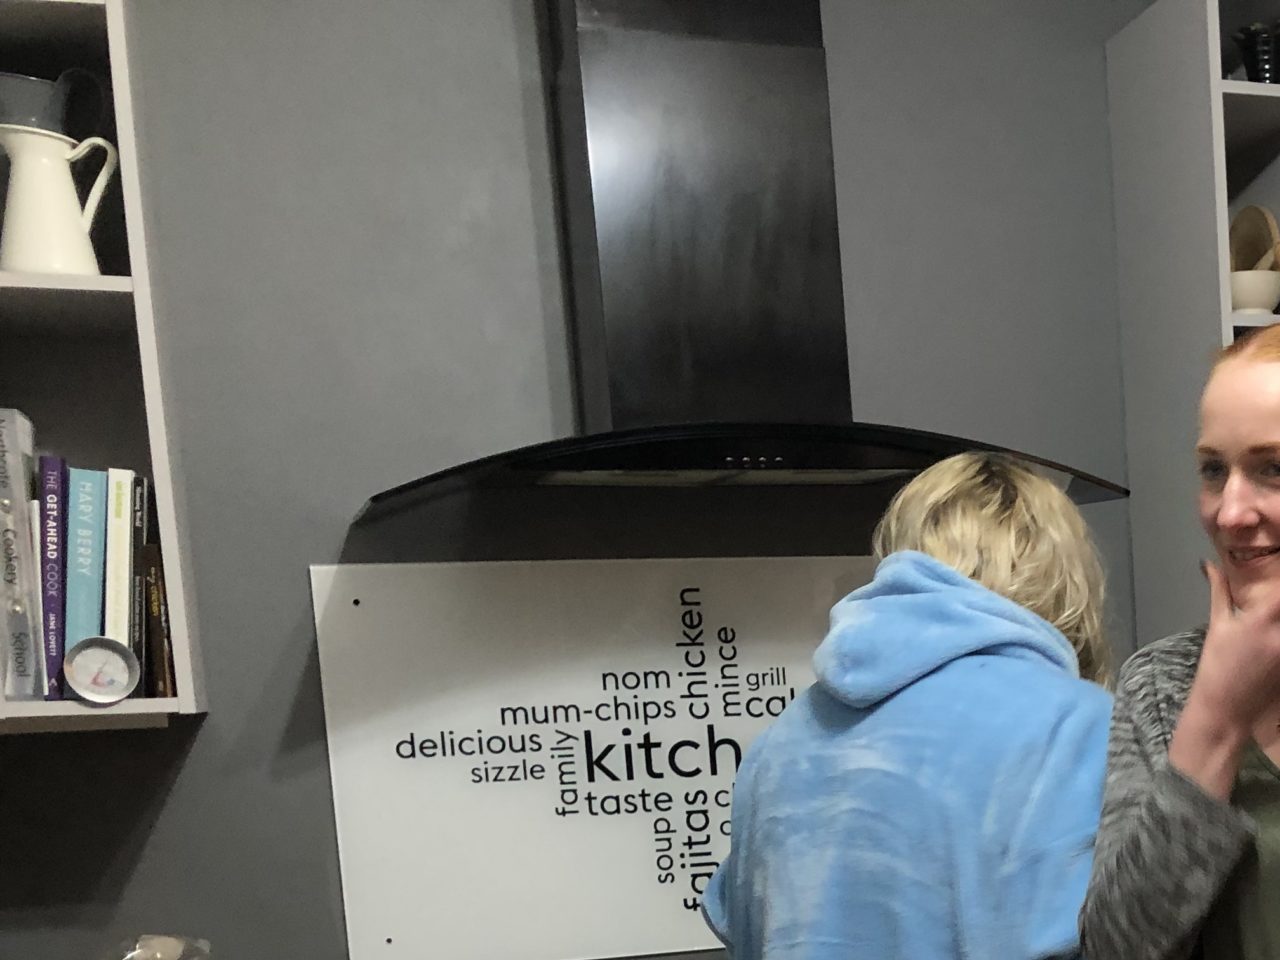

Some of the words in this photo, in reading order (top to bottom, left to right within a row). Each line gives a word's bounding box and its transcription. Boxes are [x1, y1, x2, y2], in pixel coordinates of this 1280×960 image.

[46, 470, 58, 490] THE
[78, 481, 94, 524] MARY
[46, 494, 58, 560] GET-AHEAD
[77, 528, 93, 576] BERRY
[46, 563, 59, 598] COOK
[3, 528, 18, 586] Cookery
[12, 631, 31, 678] School
[676, 587, 709, 720] chicken
[714, 626, 742, 717] mince
[601, 669, 670, 691] nom
[746, 666, 786, 691] grill
[500, 695, 677, 726] mum-chips
[395, 728, 543, 759] delicious
[470, 759, 546, 784] sizzle
[550, 729, 580, 817] family
[584, 788, 674, 816] taste
[653, 817, 677, 884] soup
